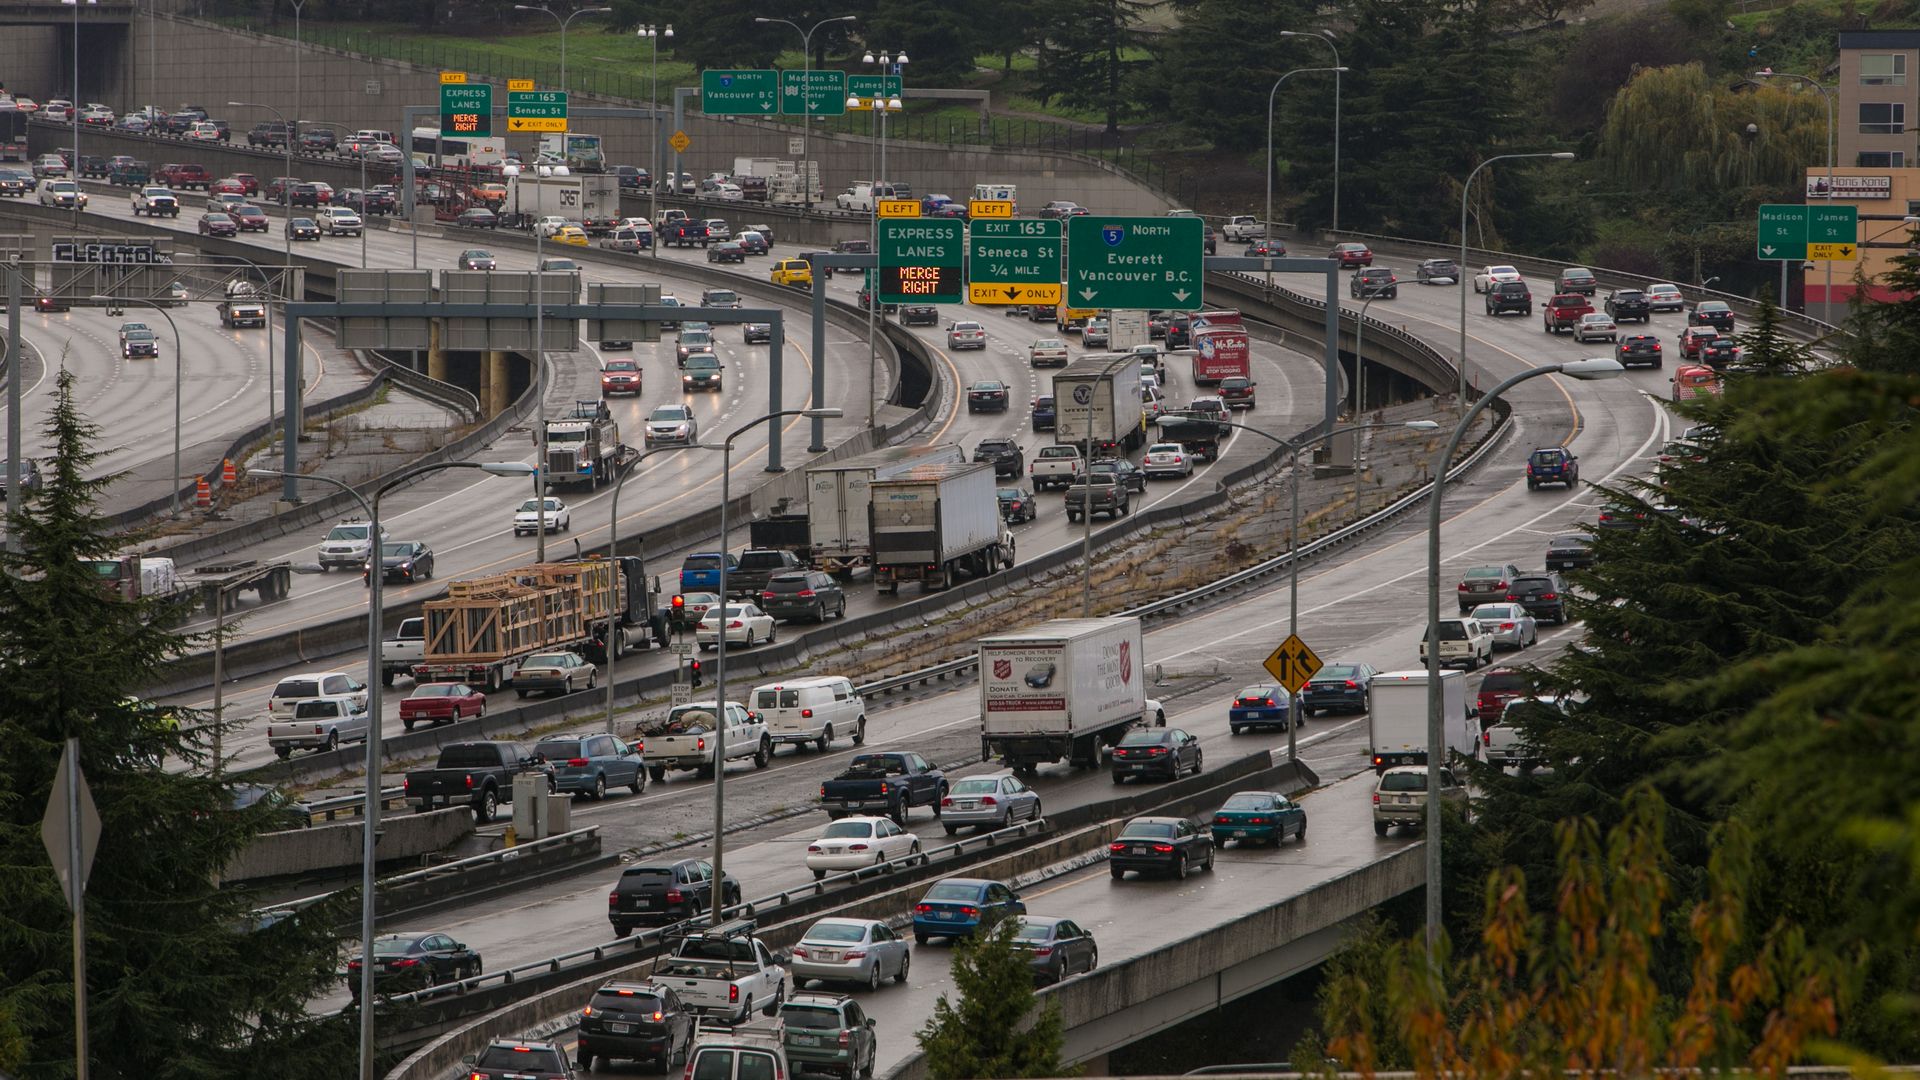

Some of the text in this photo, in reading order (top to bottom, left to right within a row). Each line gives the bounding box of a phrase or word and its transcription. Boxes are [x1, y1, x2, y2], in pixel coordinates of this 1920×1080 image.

[893, 64, 901, 74] H
[788, 74, 839, 82] Madson St
[853, 81, 897, 90] James St
[446, 89, 487, 98] EXPRESS
[539, 93, 556, 102] 165
[708, 91, 755, 99] Vancouver
[451, 101, 481, 109] LANES
[514, 106, 561, 115] Seneca St
[453, 113, 478, 123] MERGE
[455, 122, 478, 132] RIGHT
[545, 121, 564, 129] ONLY
[560, 189, 580, 206] CRST
[886, 204, 913, 213] LEFT
[977, 205, 1005, 213] LEFT
[1762, 212, 1803, 221] Madison
[1817, 213, 1849, 221] James
[986, 222, 1046, 235] EXIT 165
[1133, 224, 1171, 236] NORTH
[888, 228, 954, 239] EXPRESS
[1110, 230, 1117, 242] 5
[897, 246, 945, 257] LANES
[977, 246, 1054, 258] Seneca St
[1108, 253, 1164, 265] Everett
[899, 267, 941, 280] MERGE
[1015, 266, 1041, 275] MILE
[1079, 269, 1193, 282] Vancouver B.C.
[902, 281, 939, 294] RIGHT
[973, 289, 1057, 298] EXIT ONLY
